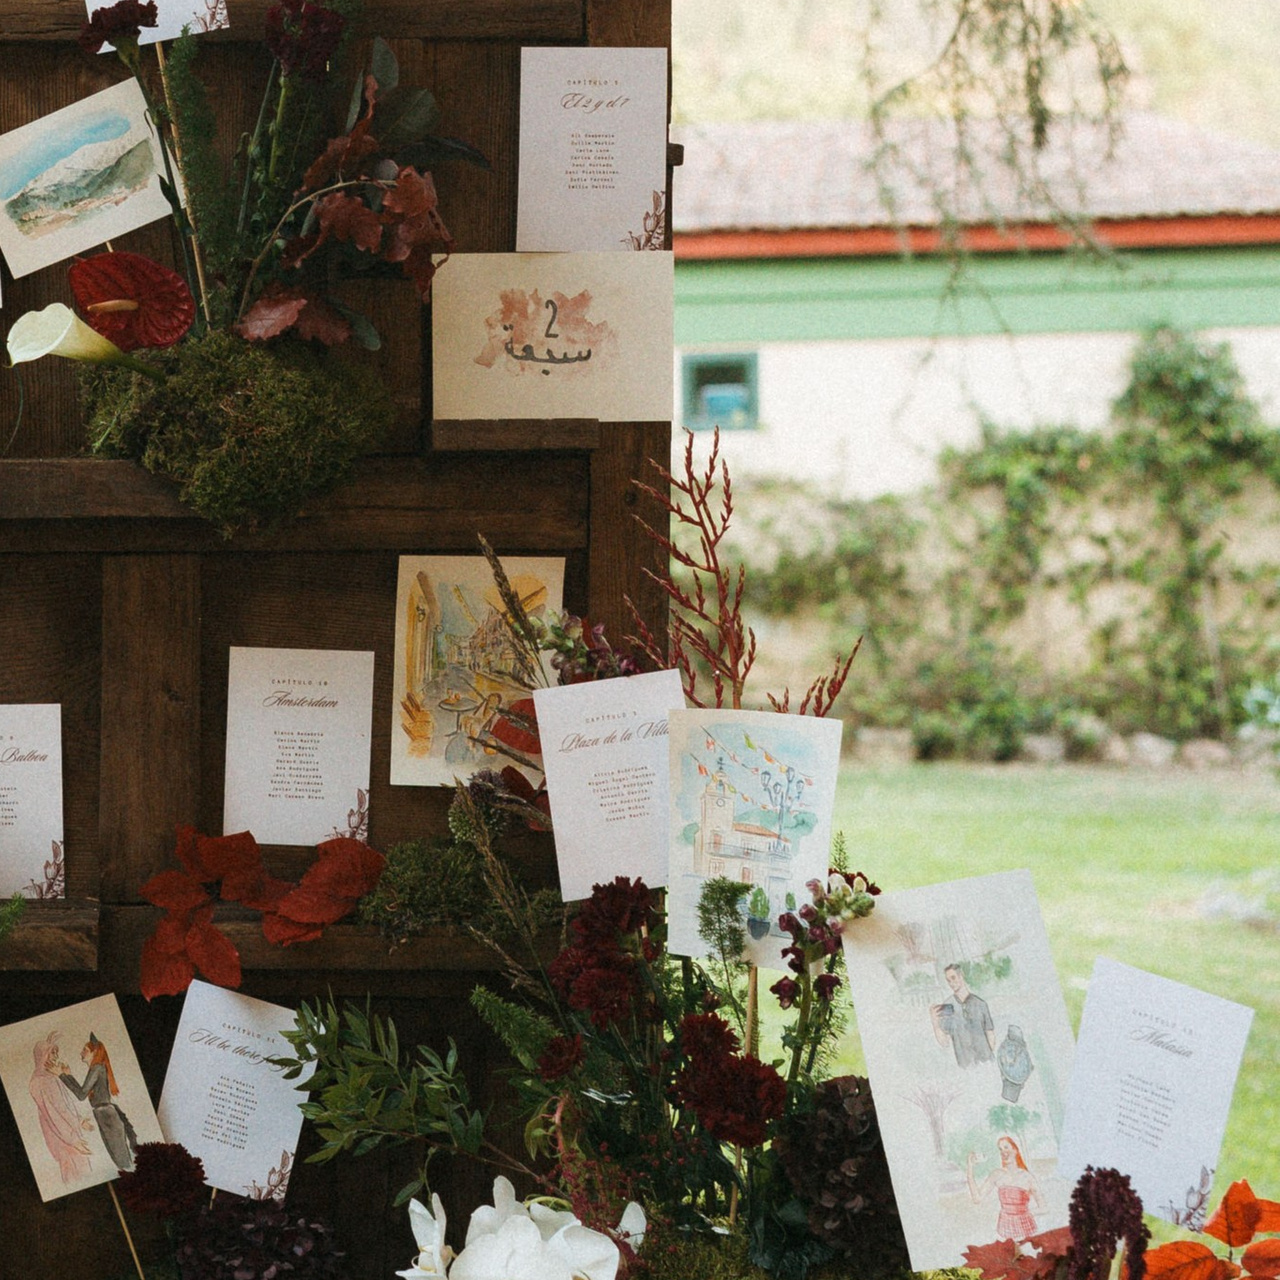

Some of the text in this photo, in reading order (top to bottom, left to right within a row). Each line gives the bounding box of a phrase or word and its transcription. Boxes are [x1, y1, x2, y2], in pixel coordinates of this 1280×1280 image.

[545, 299, 559, 338] 2
[504, 324, 592, 375] سبعة
[559, 732, 599, 754] Plaza
[603, 731, 618, 744] de
[620, 729, 633, 742] la
[0, 746, 48, 765] Balboa
[216, 1039, 232, 1051] be
